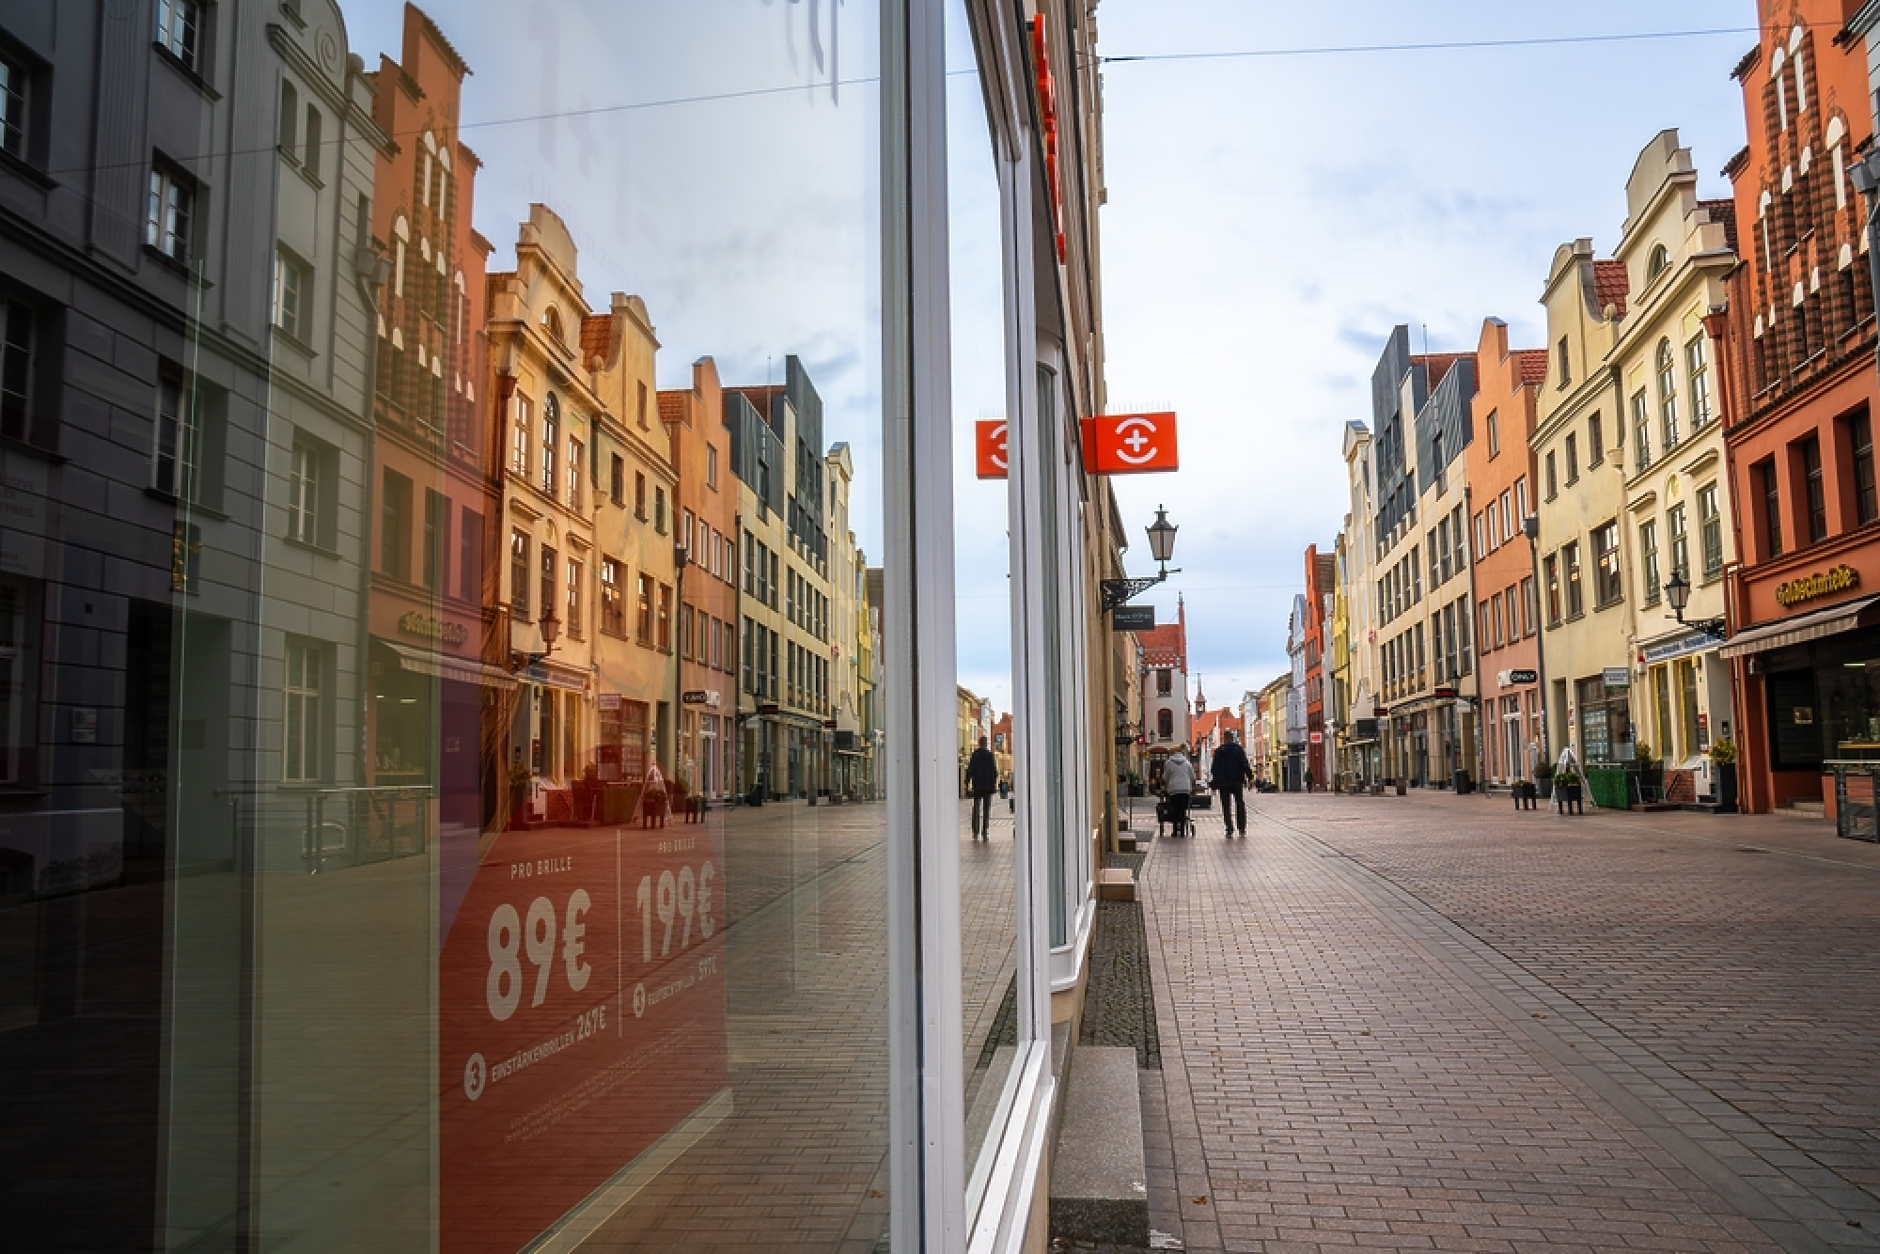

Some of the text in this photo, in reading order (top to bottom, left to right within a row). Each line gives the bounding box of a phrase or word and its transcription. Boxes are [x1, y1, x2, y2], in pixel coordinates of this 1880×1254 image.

[511, 856, 573, 881] PRO BRILLE
[637, 861, 715, 963] 199€
[487, 889, 591, 1021] 89€
[577, 1005, 606, 1042] 267€
